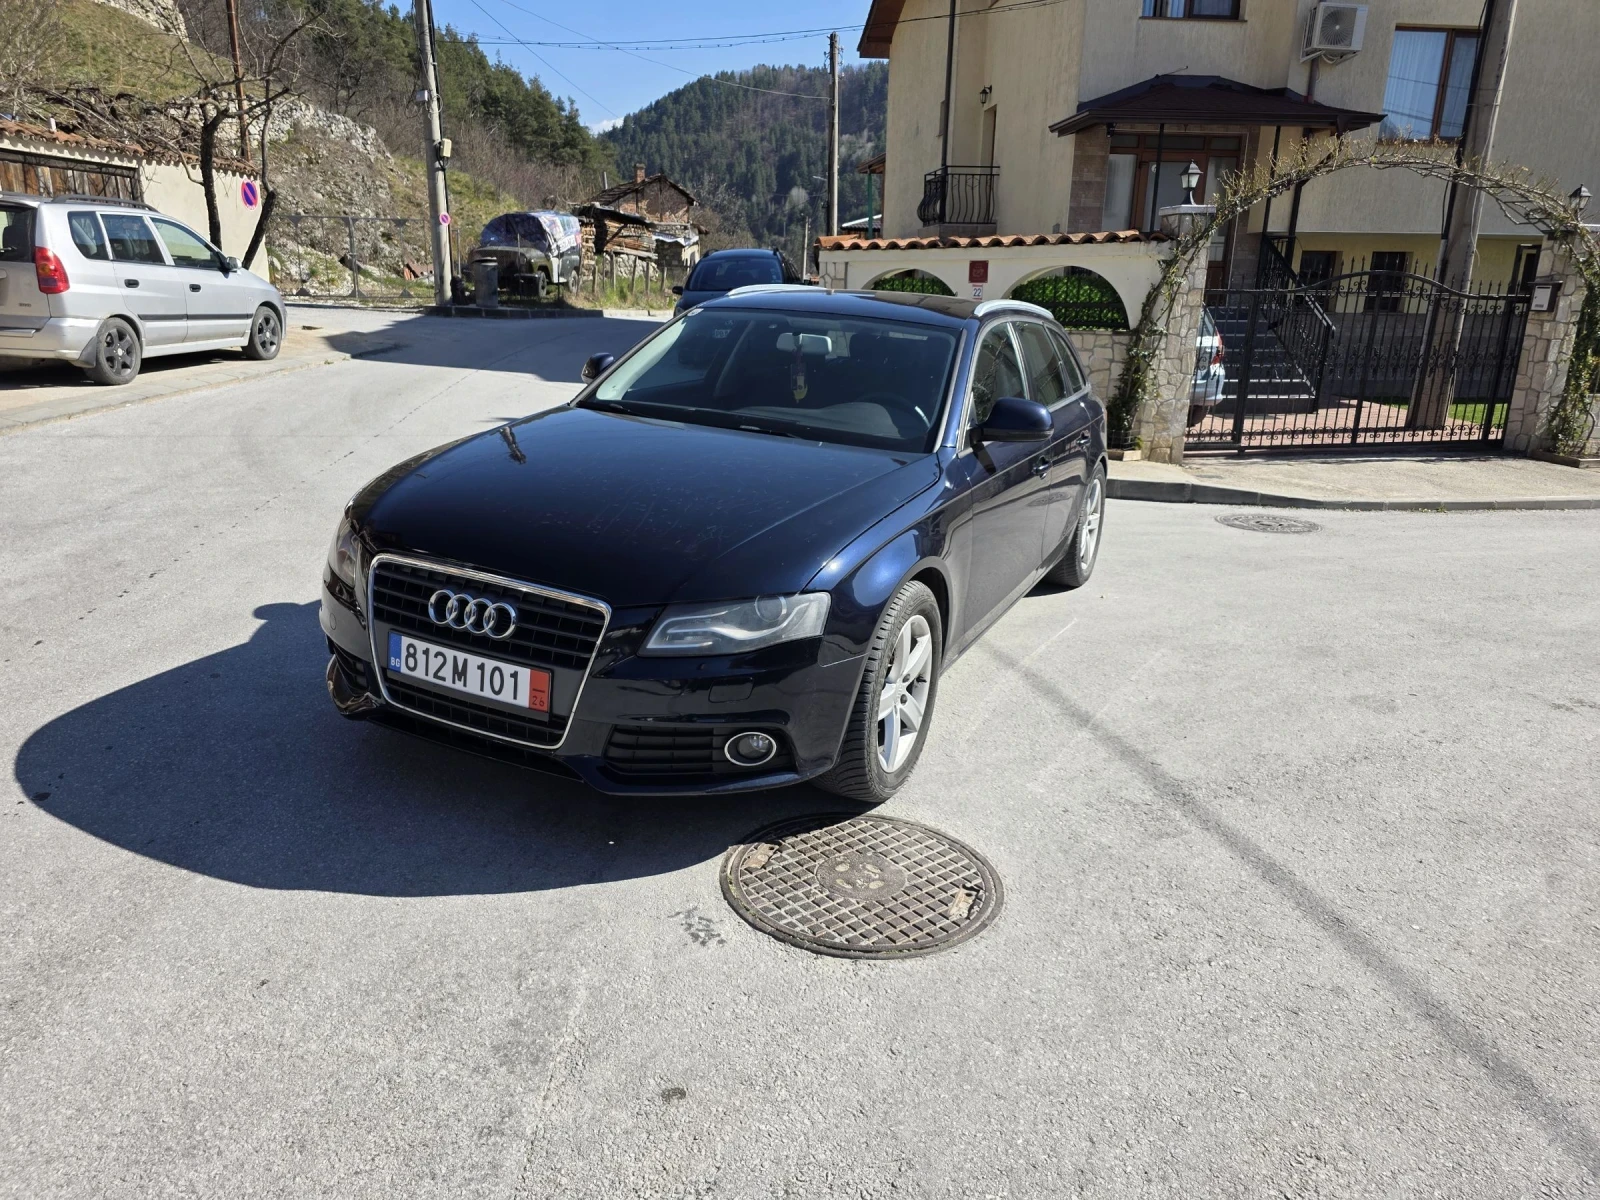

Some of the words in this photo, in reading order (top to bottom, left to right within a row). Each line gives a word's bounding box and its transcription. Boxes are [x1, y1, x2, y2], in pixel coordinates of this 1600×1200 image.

[973, 287, 982, 297] 22
[390, 656, 401, 668] BG
[531, 694, 545, 708] 26
